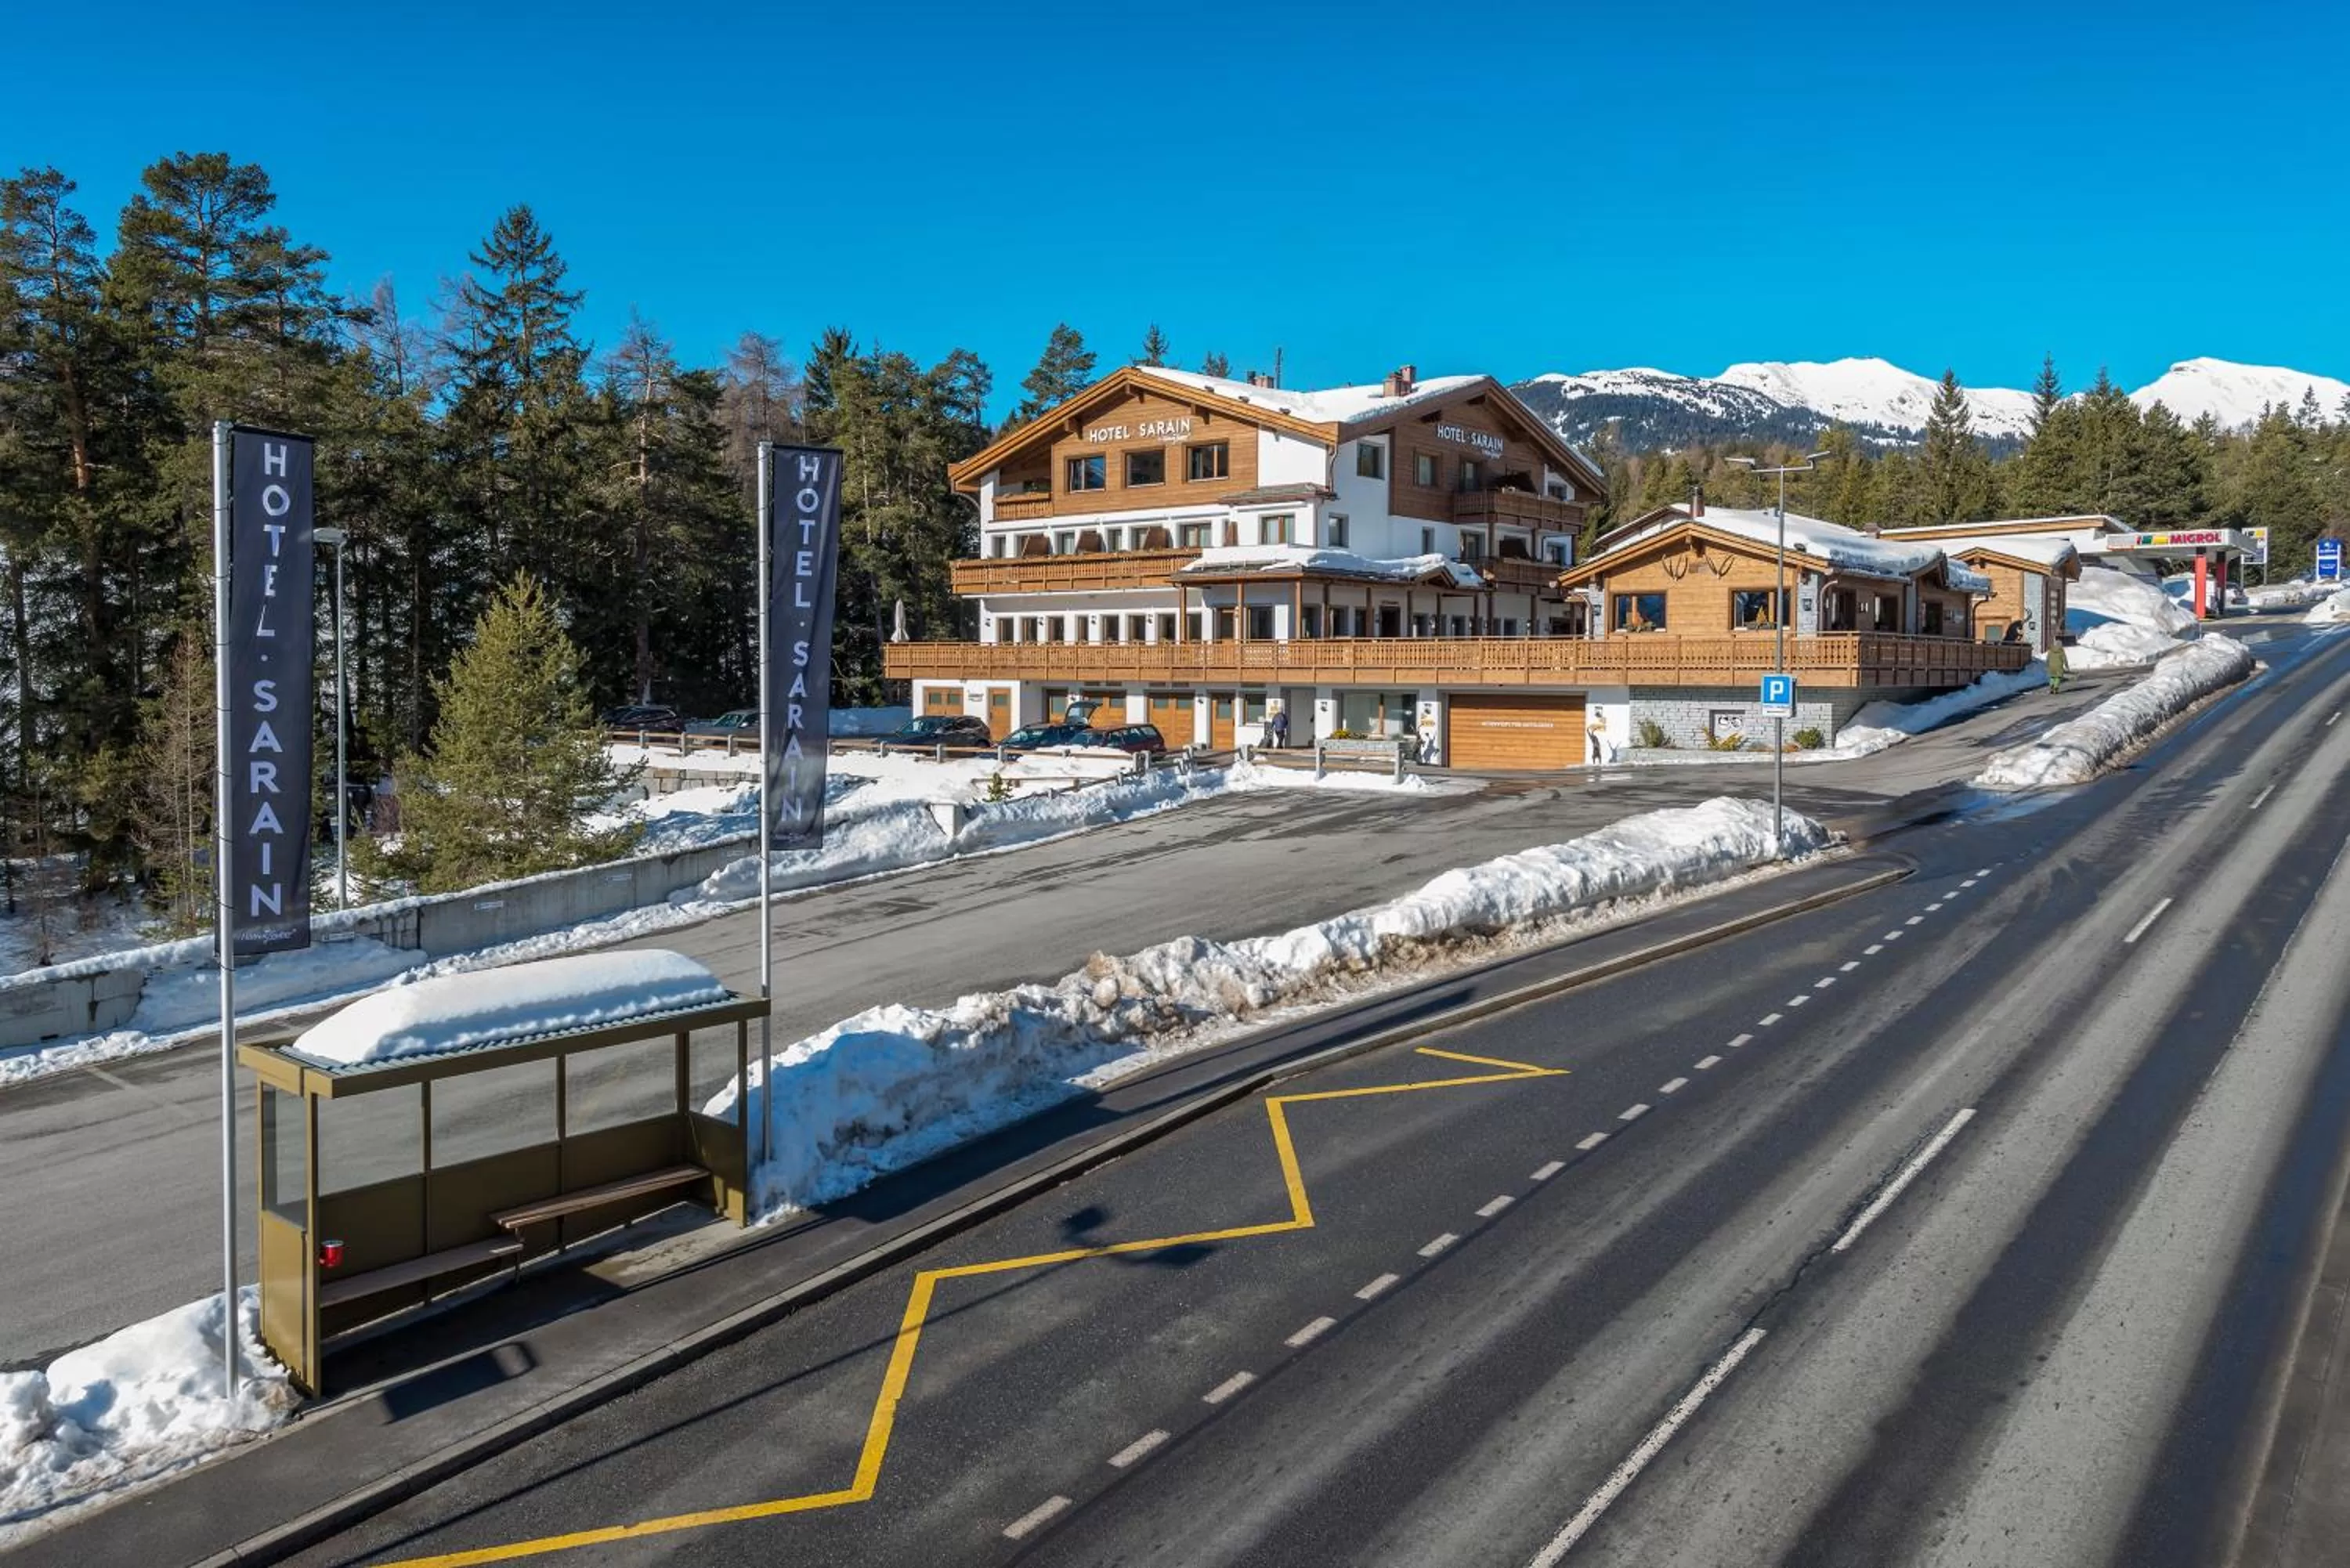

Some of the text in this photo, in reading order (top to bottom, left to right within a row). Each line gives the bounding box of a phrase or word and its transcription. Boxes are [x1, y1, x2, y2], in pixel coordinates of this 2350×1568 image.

[1090, 417, 1191, 443] HOTEL SARAIN
[1437, 425, 1503, 452] HOTEL SARAIN
[256, 443, 291, 637] HOTEL
[795, 455, 821, 609] HOTEL
[2169, 533, 2222, 544] MIGROL
[781, 641, 809, 822] SARAIN
[1770, 681, 1784, 702] P
[249, 679, 283, 916] SARAIN
